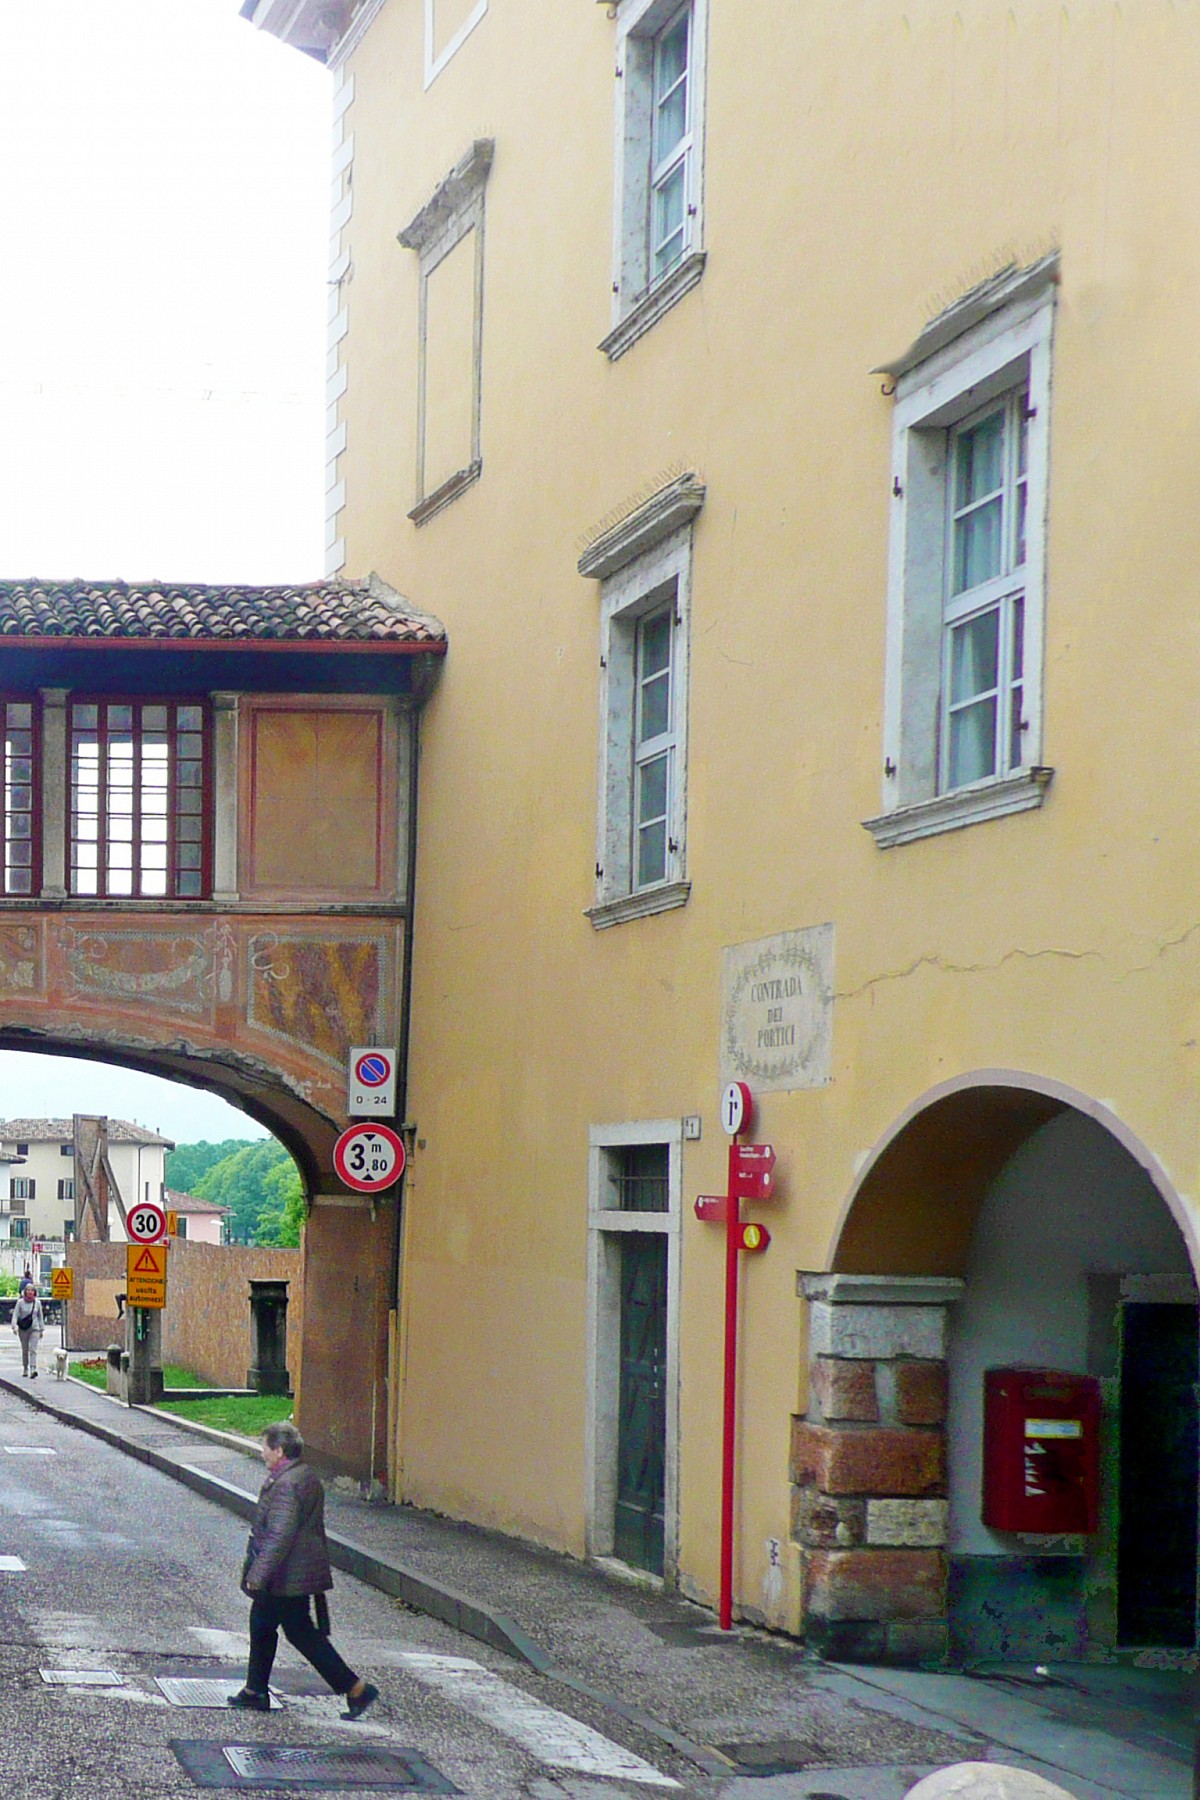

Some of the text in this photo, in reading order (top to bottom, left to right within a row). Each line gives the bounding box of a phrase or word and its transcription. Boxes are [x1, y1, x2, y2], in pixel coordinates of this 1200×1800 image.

[751, 976, 802, 1002] CONTRADA
[767, 1007, 782, 1023] DEI
[757, 1024, 795, 1048] PORTICI
[135, 1213, 158, 1233] 30
